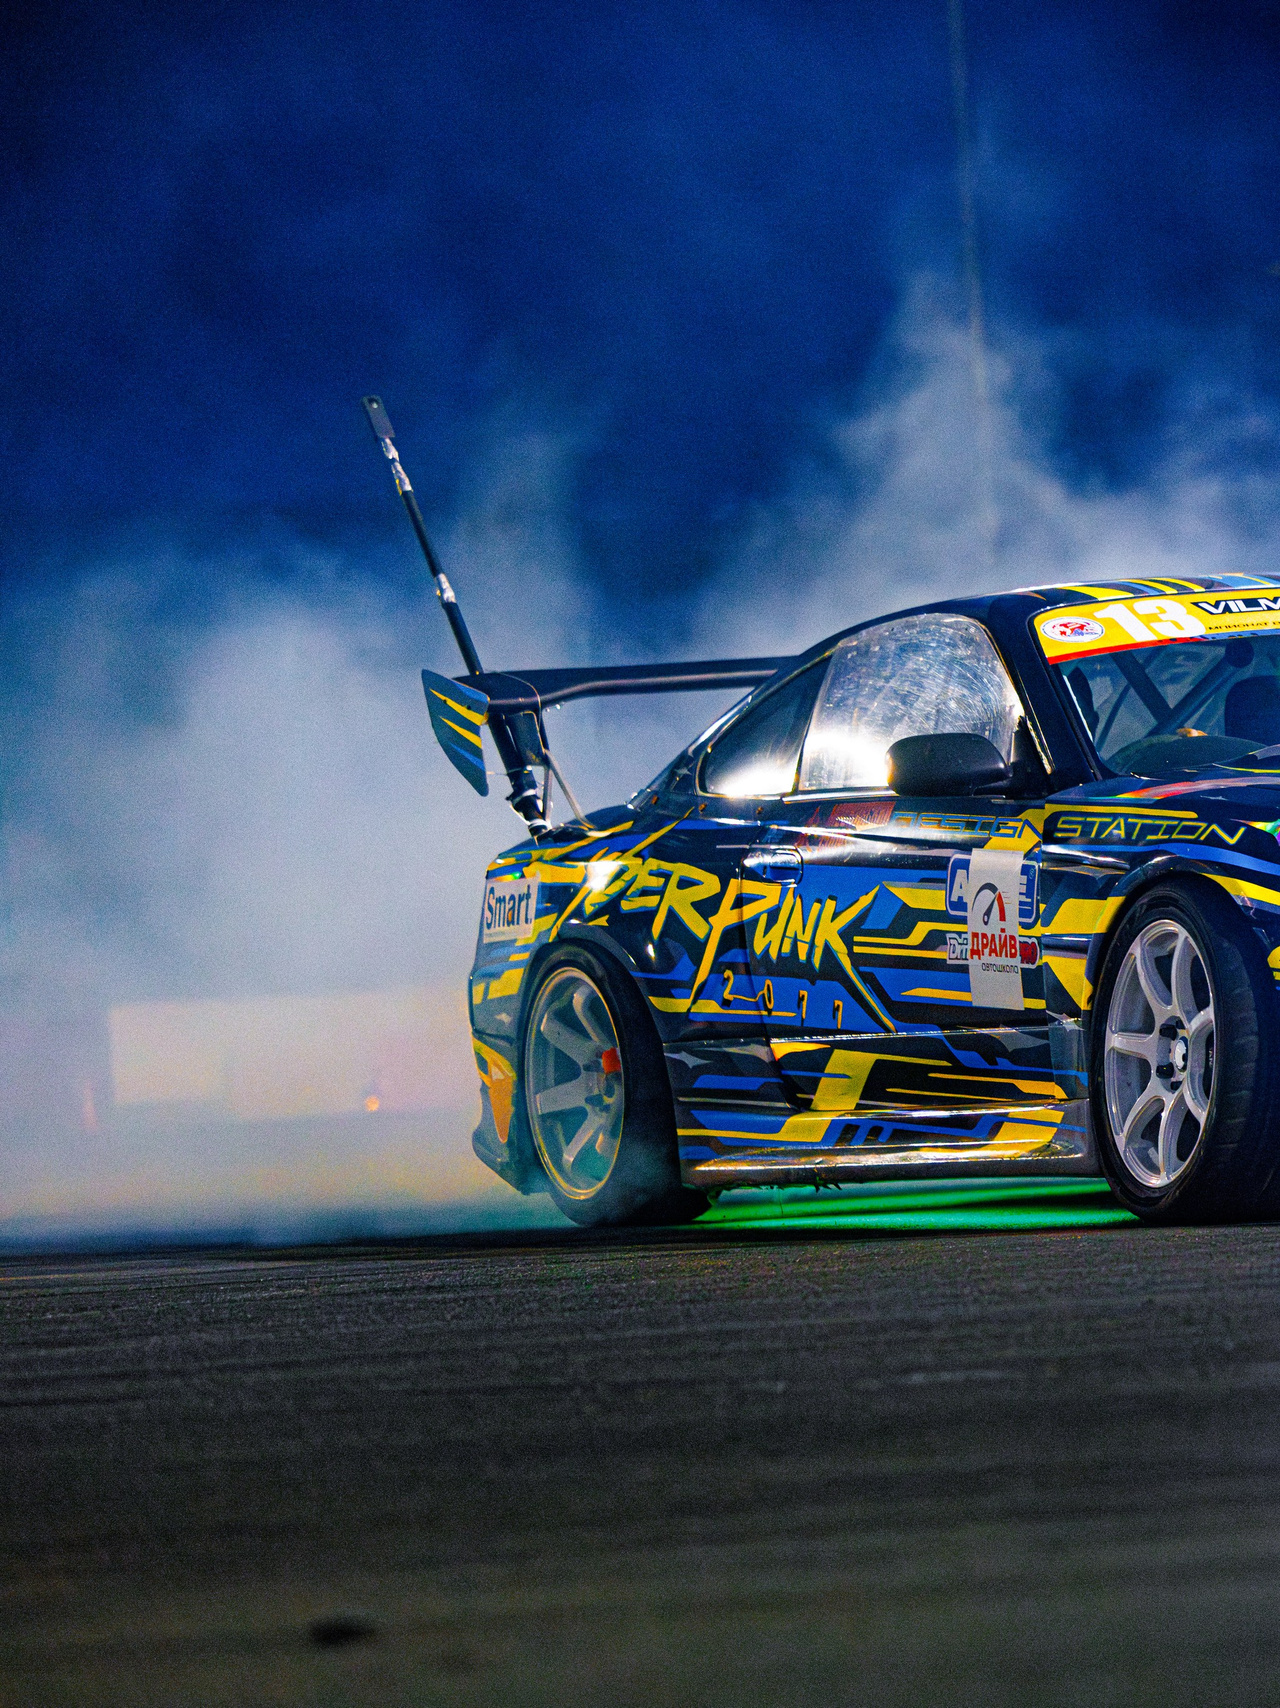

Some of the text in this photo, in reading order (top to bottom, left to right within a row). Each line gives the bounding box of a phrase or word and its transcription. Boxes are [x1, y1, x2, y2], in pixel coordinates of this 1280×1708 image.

[1093, 598, 1206, 642] 13
[1208, 622, 1269, 631] МПИОНАТ
[1052, 815, 1248, 845] STATION
[969, 927, 1019, 961] ДРАЙВ
[981, 962, 1019, 975] автошкола
[722, 969, 843, 1029] 2077
